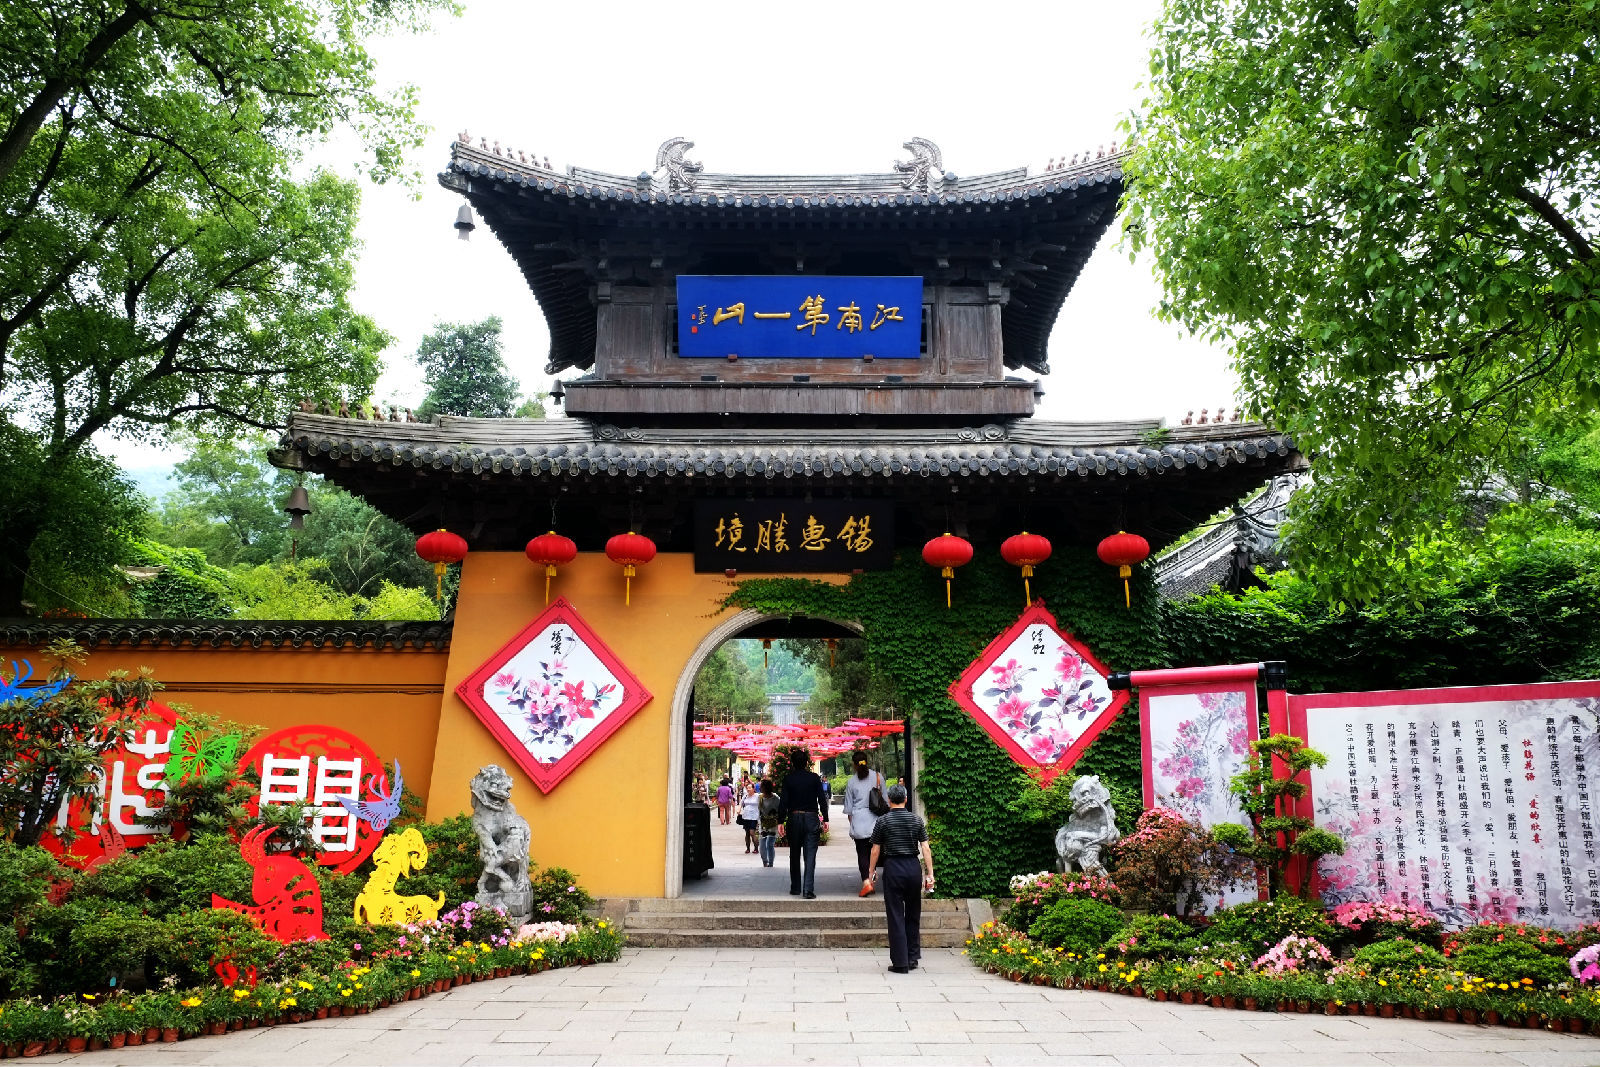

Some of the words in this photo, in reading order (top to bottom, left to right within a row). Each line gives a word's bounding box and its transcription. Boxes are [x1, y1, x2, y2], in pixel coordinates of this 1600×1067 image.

[713, 295, 904, 336] 江南第一山
